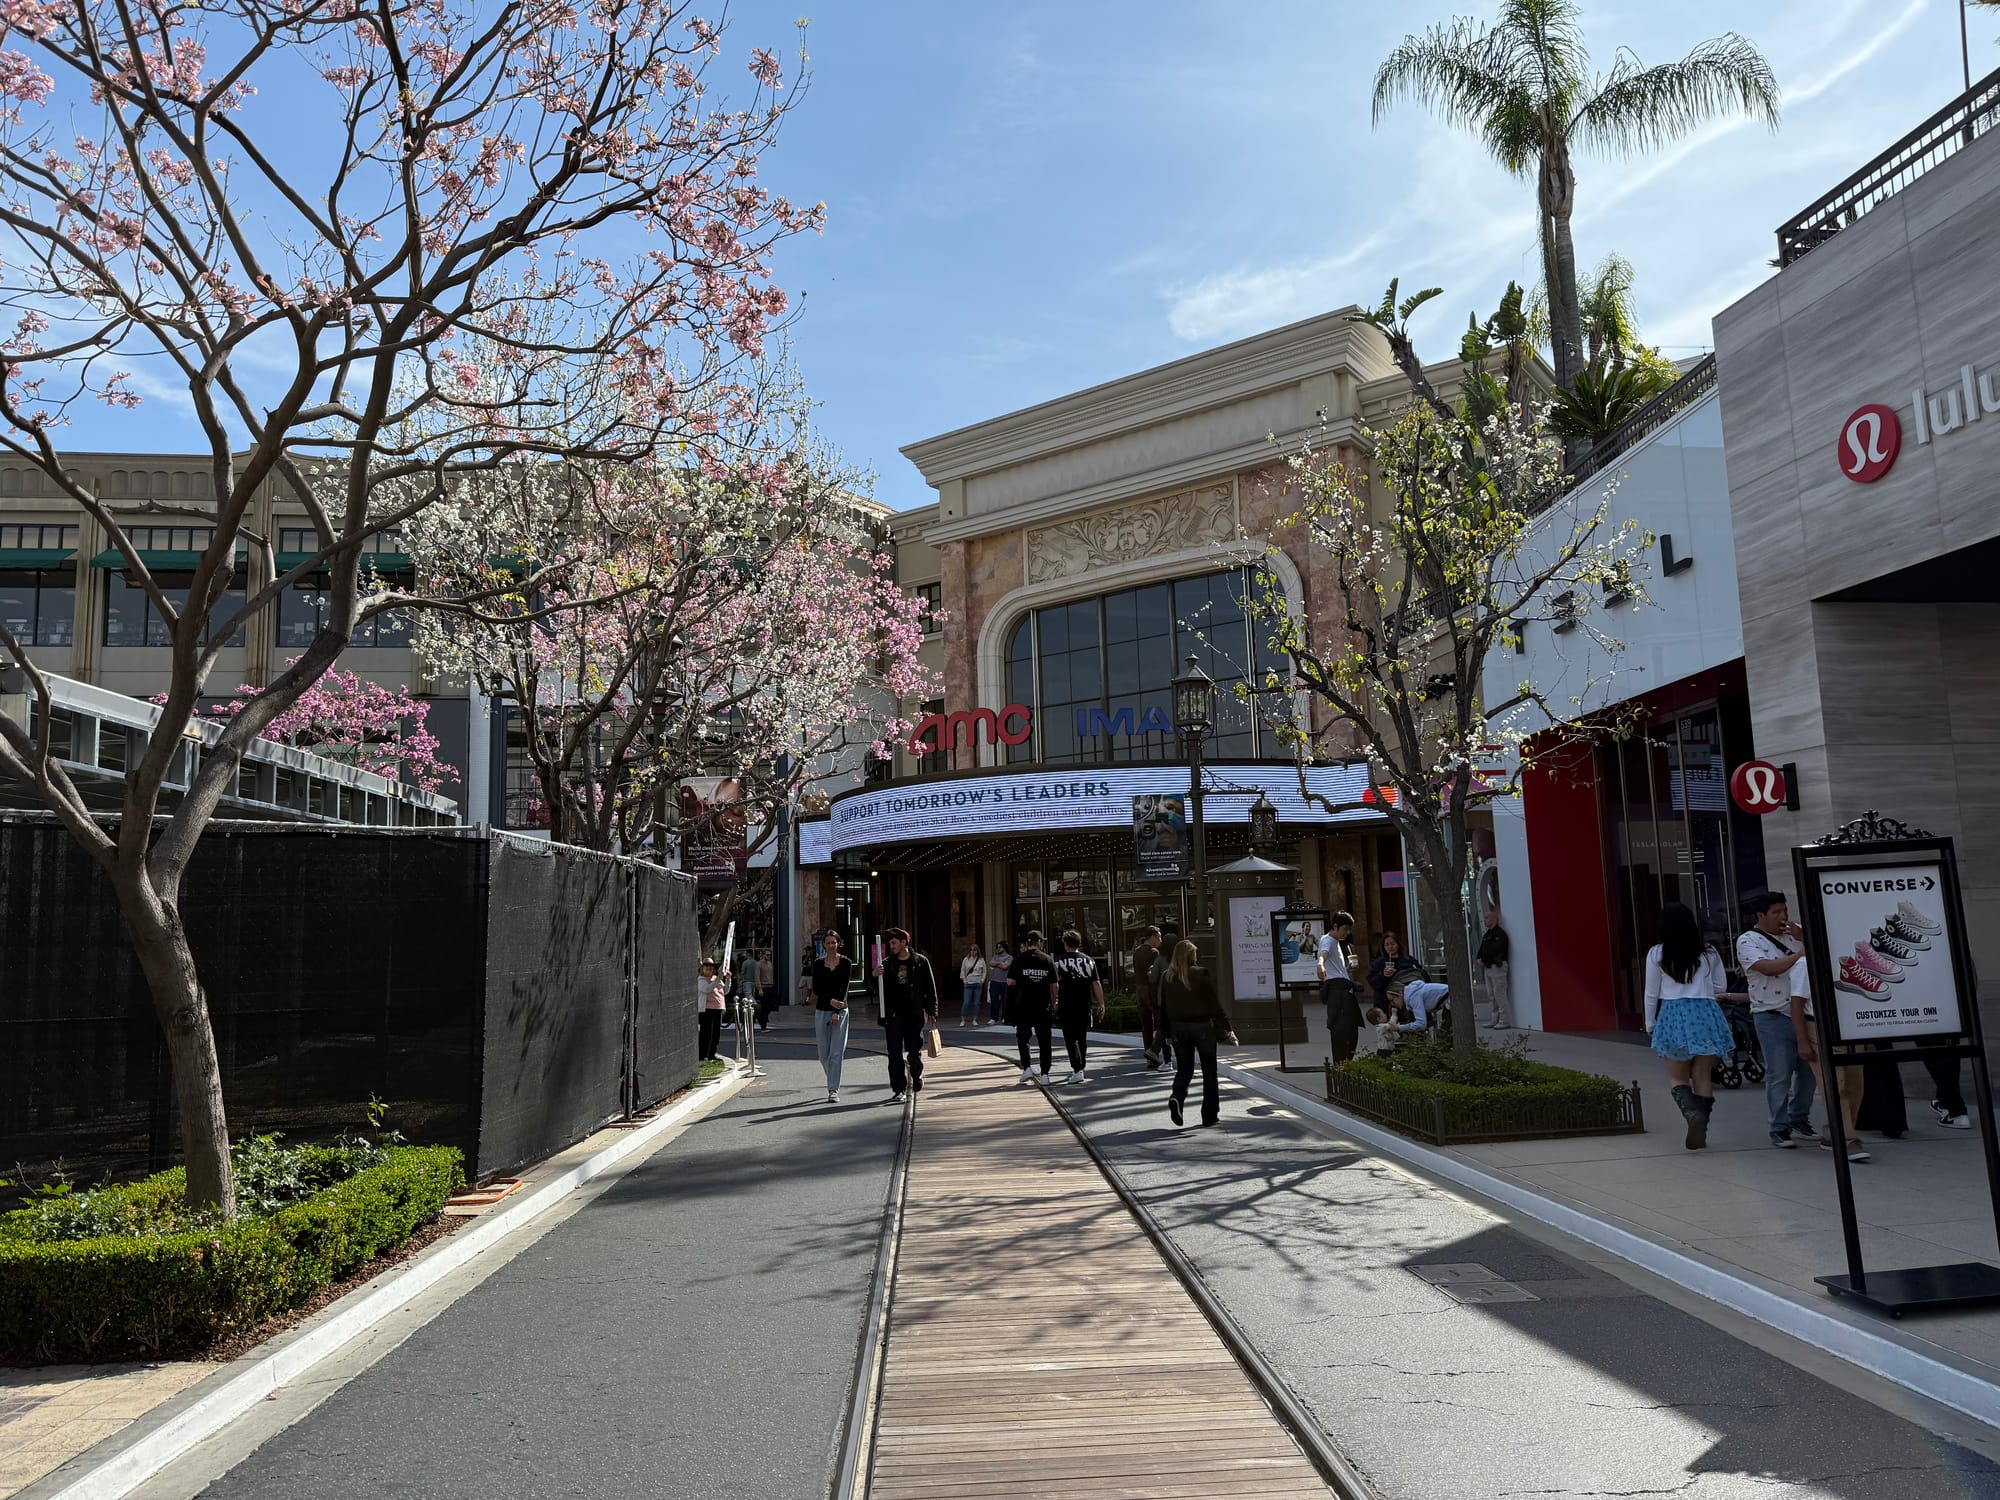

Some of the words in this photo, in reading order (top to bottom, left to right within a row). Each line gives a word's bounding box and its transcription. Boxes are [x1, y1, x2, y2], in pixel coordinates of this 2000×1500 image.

[1077, 706, 1213, 736] IMA
[1680, 718, 1692, 730] 539
[840, 802, 881, 823] SUPPORT
[885, 788, 1003, 813] TOMORROW'S
[1012, 781, 1110, 801] LEADERS
[894, 820, 919, 831] support
[921, 818, 929, 826] to
[930, 816, 949, 826] Skid
[951, 814, 975, 824] Row's
[979, 812, 1015, 822] neediest
[1019, 808, 1059, 819] children
[1062, 807, 1081, 816] and
[1822, 878, 1917, 895] CONVERSE
[1856, 1009, 1897, 1020] CUSTOMIZE
[1901, 1008, 1920, 1017] YOUR
[1923, 1007, 1938, 1016] OWN
